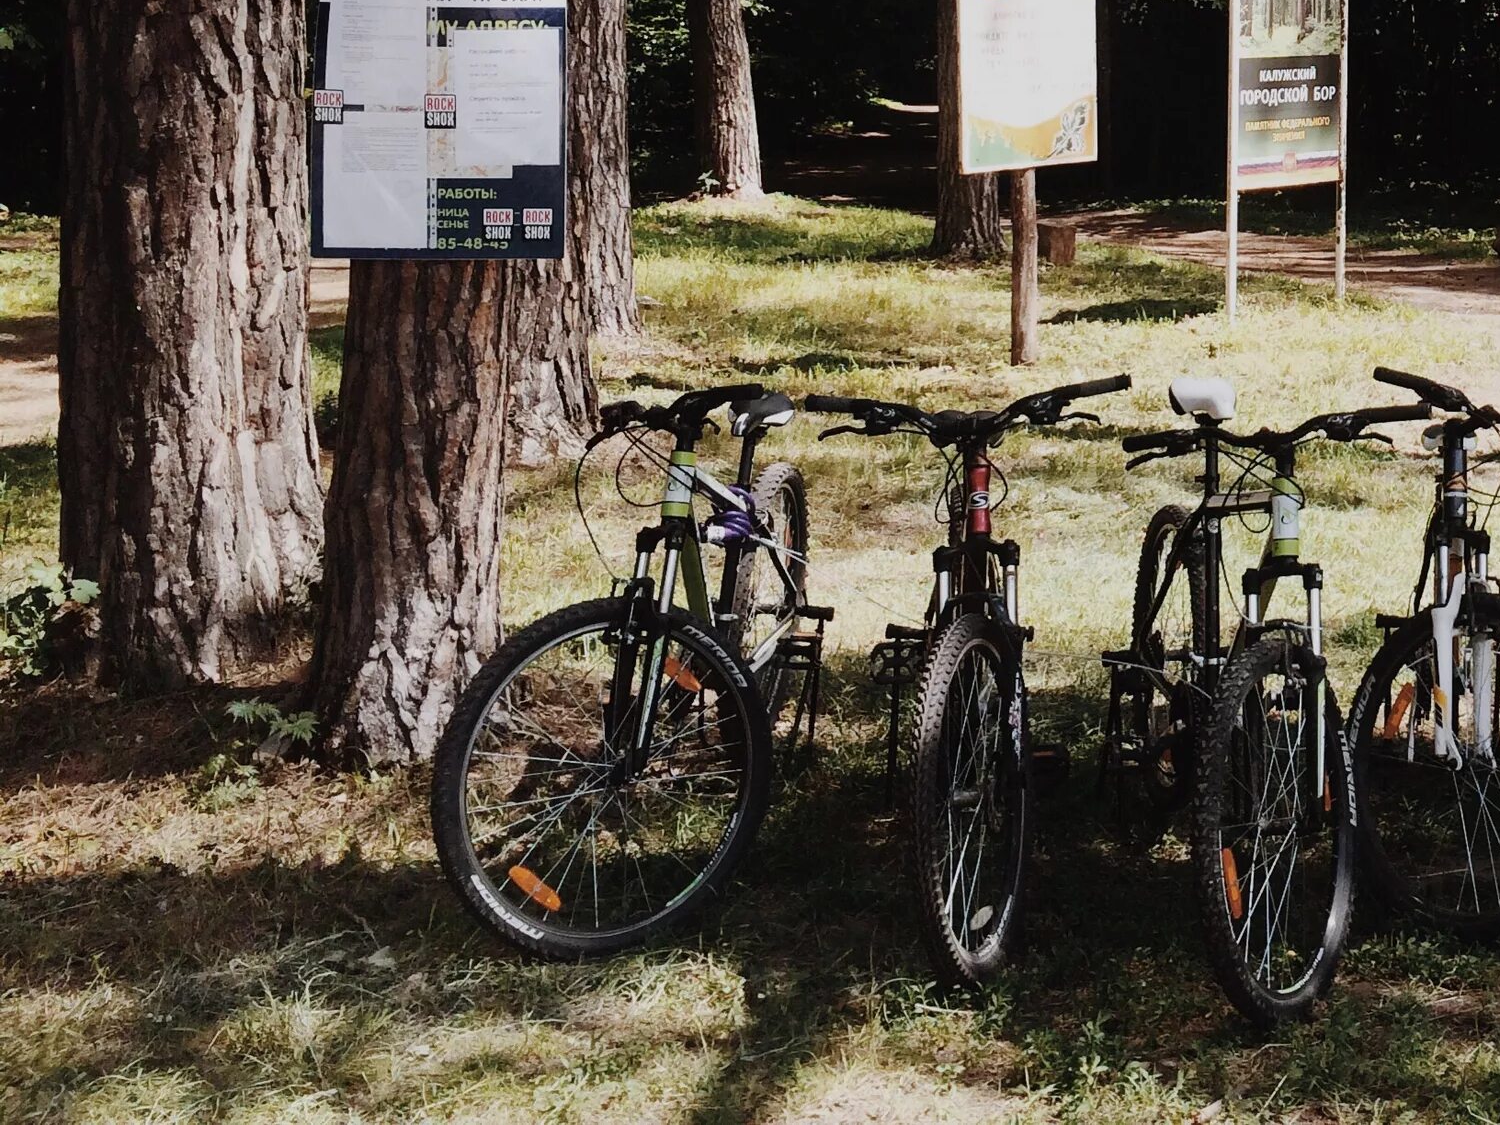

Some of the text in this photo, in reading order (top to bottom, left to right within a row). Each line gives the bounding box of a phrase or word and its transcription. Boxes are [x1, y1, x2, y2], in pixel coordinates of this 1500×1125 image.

[1259, 65, 1316, 82] КАЛУЖСКИЙ
[315, 92, 342, 106] ROCK
[1240, 84, 1337, 107] ГОРОДСКОЙ БОР
[427, 97, 454, 111] ROCK
[315, 108, 342, 122] SHOX
[427, 112, 455, 127] SHOX
[1281, 116, 1331, 131] ФЕДЕРАЛЬНОГО
[437, 188, 497, 200] РАБОТЫ:
[437, 208, 469, 218] НИЦА
[485, 211, 511, 223] ROCK
[525, 211, 551, 223] ROCK
[436, 220, 469, 229] СЕНЬЕ
[485, 226, 511, 240] SHOX
[524, 226, 551, 240] SHOX
[681, 624, 749, 688] MERIDA
[1337, 730, 1358, 828] MERIDA
[470, 874, 545, 940] MERIDA
